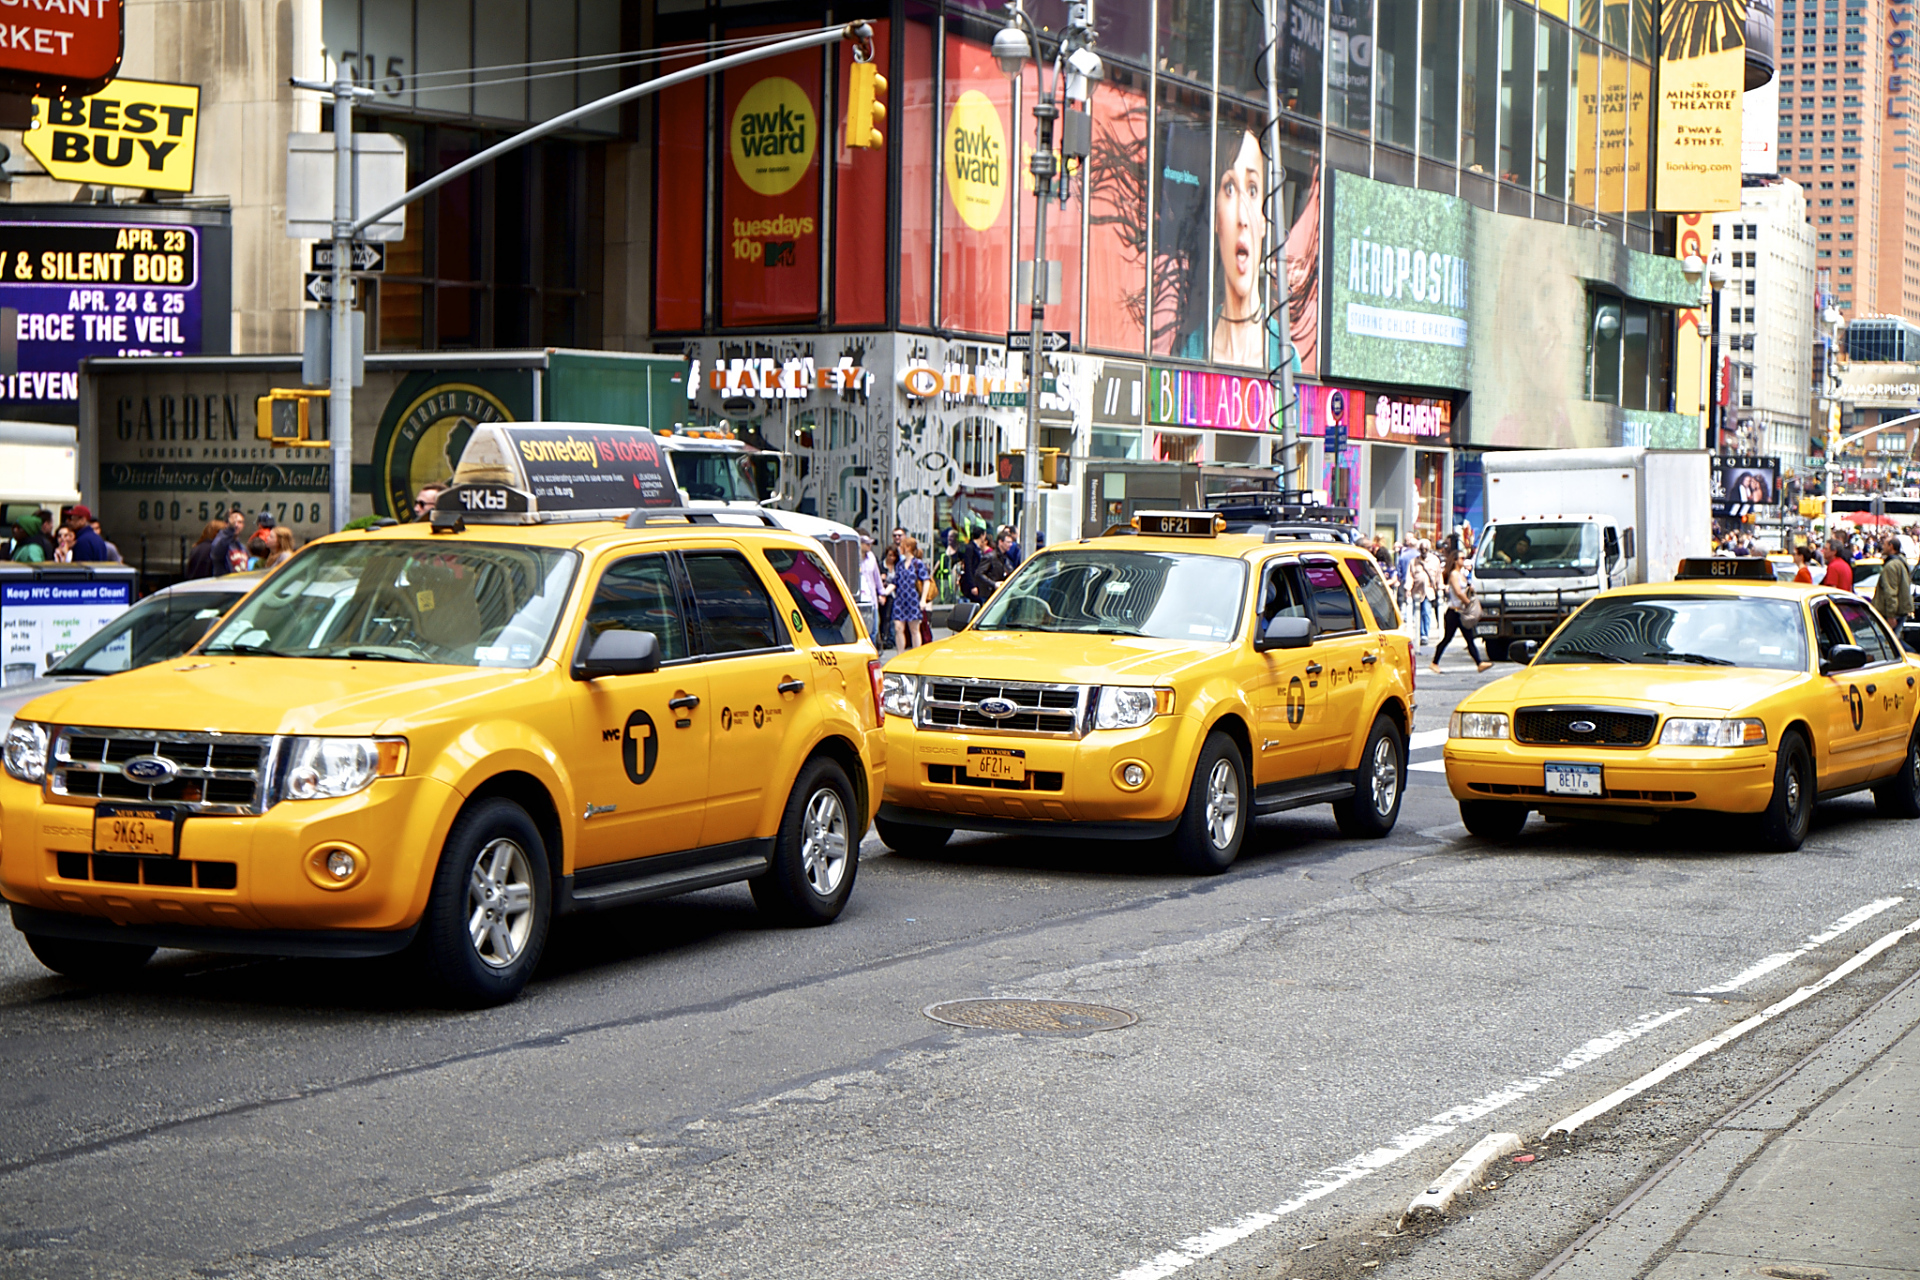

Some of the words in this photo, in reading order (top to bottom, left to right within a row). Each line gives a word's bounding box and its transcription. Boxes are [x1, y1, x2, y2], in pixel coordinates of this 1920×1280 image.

[1888, 0, 1905, 118] VOTEL
[1667, 89, 1737, 100] MINSKOFF
[1671, 100, 1731, 110] THEATRE
[48, 99, 193, 138] BEST
[741, 104, 805, 135] awk-
[51, 130, 180, 172] BUY
[741, 125, 805, 158] ward
[954, 125, 999, 159] awk-
[955, 154, 999, 187] ward
[1666, 162, 1732, 174] lionking.com
[732, 213, 814, 239] tuesdays
[116, 228, 158, 250] APR.
[164, 231, 186, 251] 23
[732, 239, 762, 262] 10p
[15, 251, 33, 280] &
[41, 251, 125, 281] SILENT
[133, 253, 184, 283] BOB
[68, 290, 109, 311] APR.
[115, 291, 137, 312] 24
[142, 291, 157, 313] &
[162, 293, 185, 313] 25
[17, 314, 75, 341] ERCE
[82, 315, 127, 342] THE
[135, 316, 185, 343] VEIL
[1350, 311, 1383, 331] STARRING
[709, 366, 866, 390] OAKLEY
[991, 393, 1001, 405] W
[1002, 392, 1016, 405] 44
[1160, 369, 1297, 434] BILLABON
[117, 394, 239, 441] GARDEN
[402, 392, 457, 441] GARDEN
[1390, 400, 1442, 437] ELEMENT
[203, 448, 275, 458] PRODUCTS
[519, 435, 598, 469] someday
[593, 436, 615, 462] is
[610, 436, 660, 468] today
[111, 464, 199, 486] Distributors
[202, 465, 221, 492] of
[220, 465, 275, 493] Quality
[1090, 478, 1099, 523] Newsstand
[1160, 517, 1190, 533] 6F21
[1710, 561, 1738, 576] 8E17
[6, 587, 29, 600] Keep
[32, 587, 50, 599] NYC
[52, 587, 79, 599] Green
[81, 587, 97, 598] and
[99, 586, 126, 598] Clean!
[4, 619, 16, 629] put
[18, 619, 36, 628] litter
[52, 618, 80, 628] recycle
[62, 630, 71, 638] all
[10, 644, 31, 654] place
[602, 729, 620, 742] NYC
[629, 724, 651, 776] T
[920, 745, 959, 756] ESCAPE
[115, 810, 134, 818] NEW
